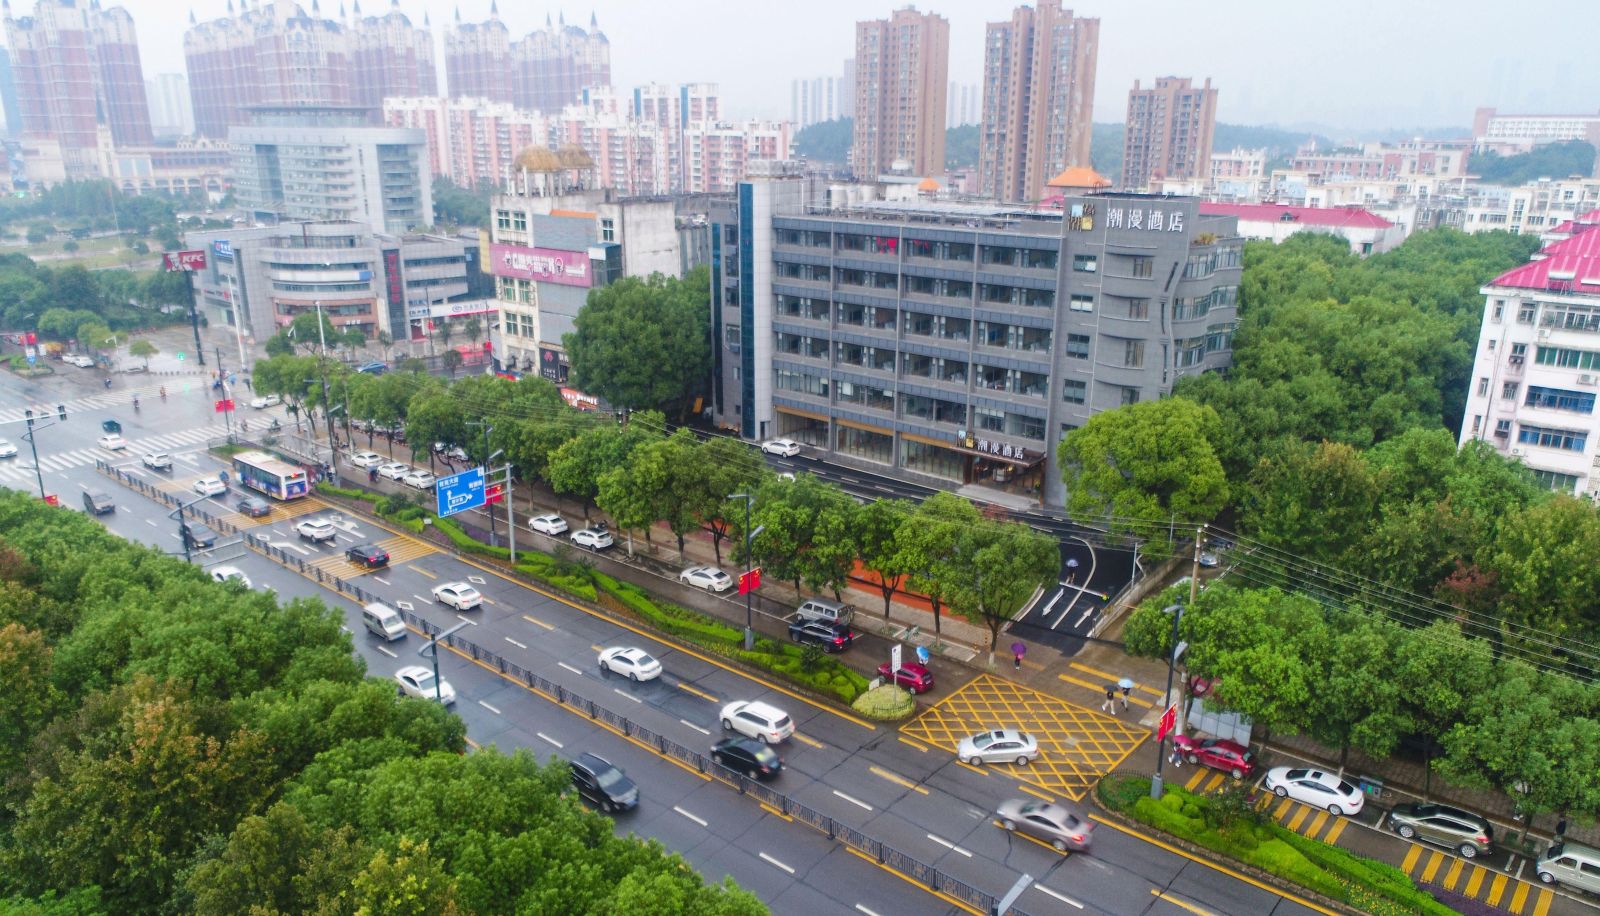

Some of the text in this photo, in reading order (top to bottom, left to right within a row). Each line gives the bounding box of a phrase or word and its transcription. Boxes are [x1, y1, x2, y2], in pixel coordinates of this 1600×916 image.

[1106, 208, 1183, 232] 潮漫酒店
[183, 254, 204, 263] KFC
[977, 439, 1024, 459] 潮漫酒店
